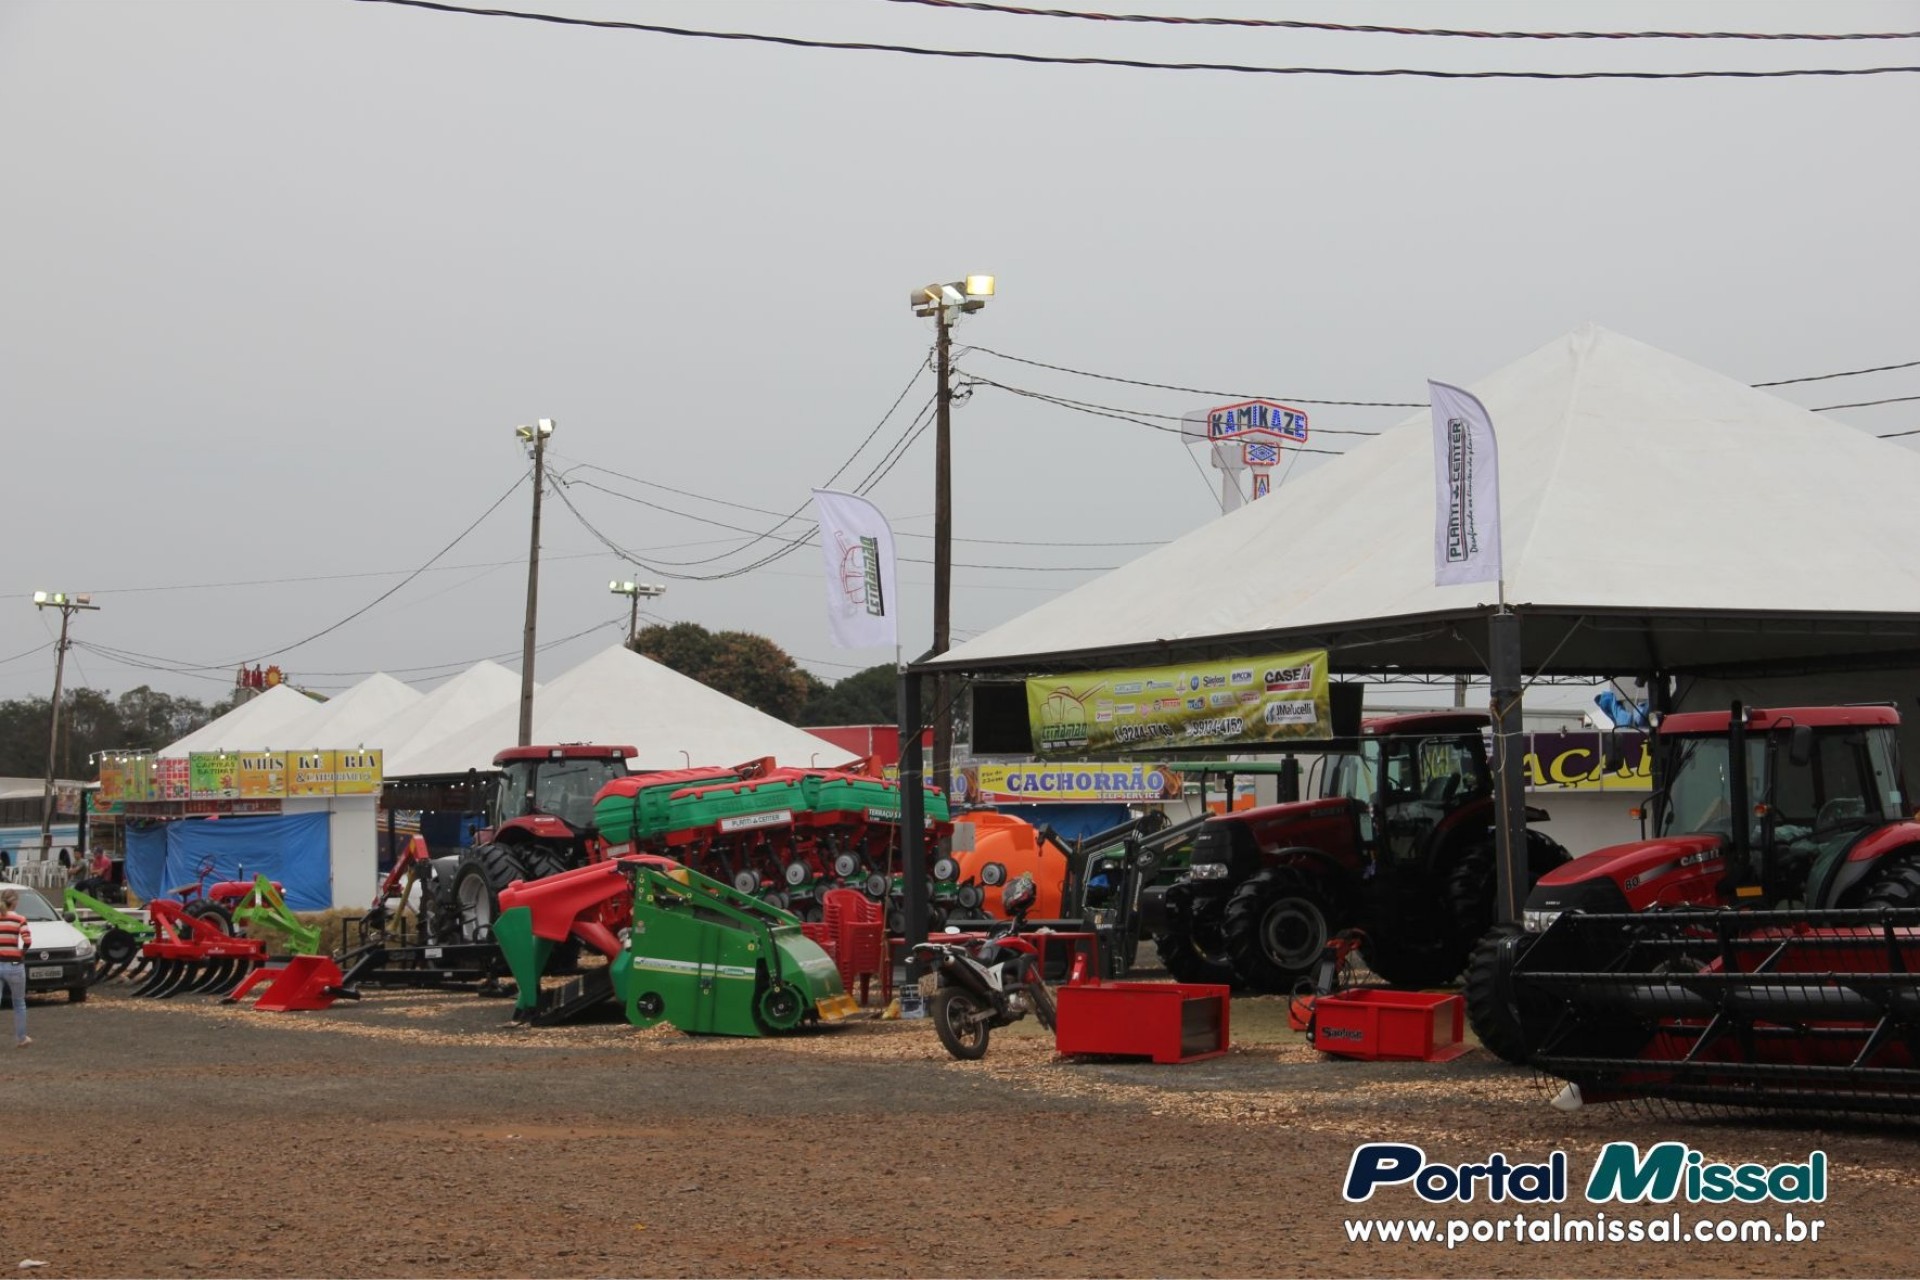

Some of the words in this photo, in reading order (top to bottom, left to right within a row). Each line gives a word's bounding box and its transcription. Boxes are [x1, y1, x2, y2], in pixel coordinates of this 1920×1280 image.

[1211, 405, 1304, 438] KAMIKAZE
[1452, 422, 1461, 482] CENTER
[1450, 504, 1461, 557] PLANTI
[1265, 669, 1300, 683] CASE
[1007, 766, 1164, 792] CACHORRÃO
